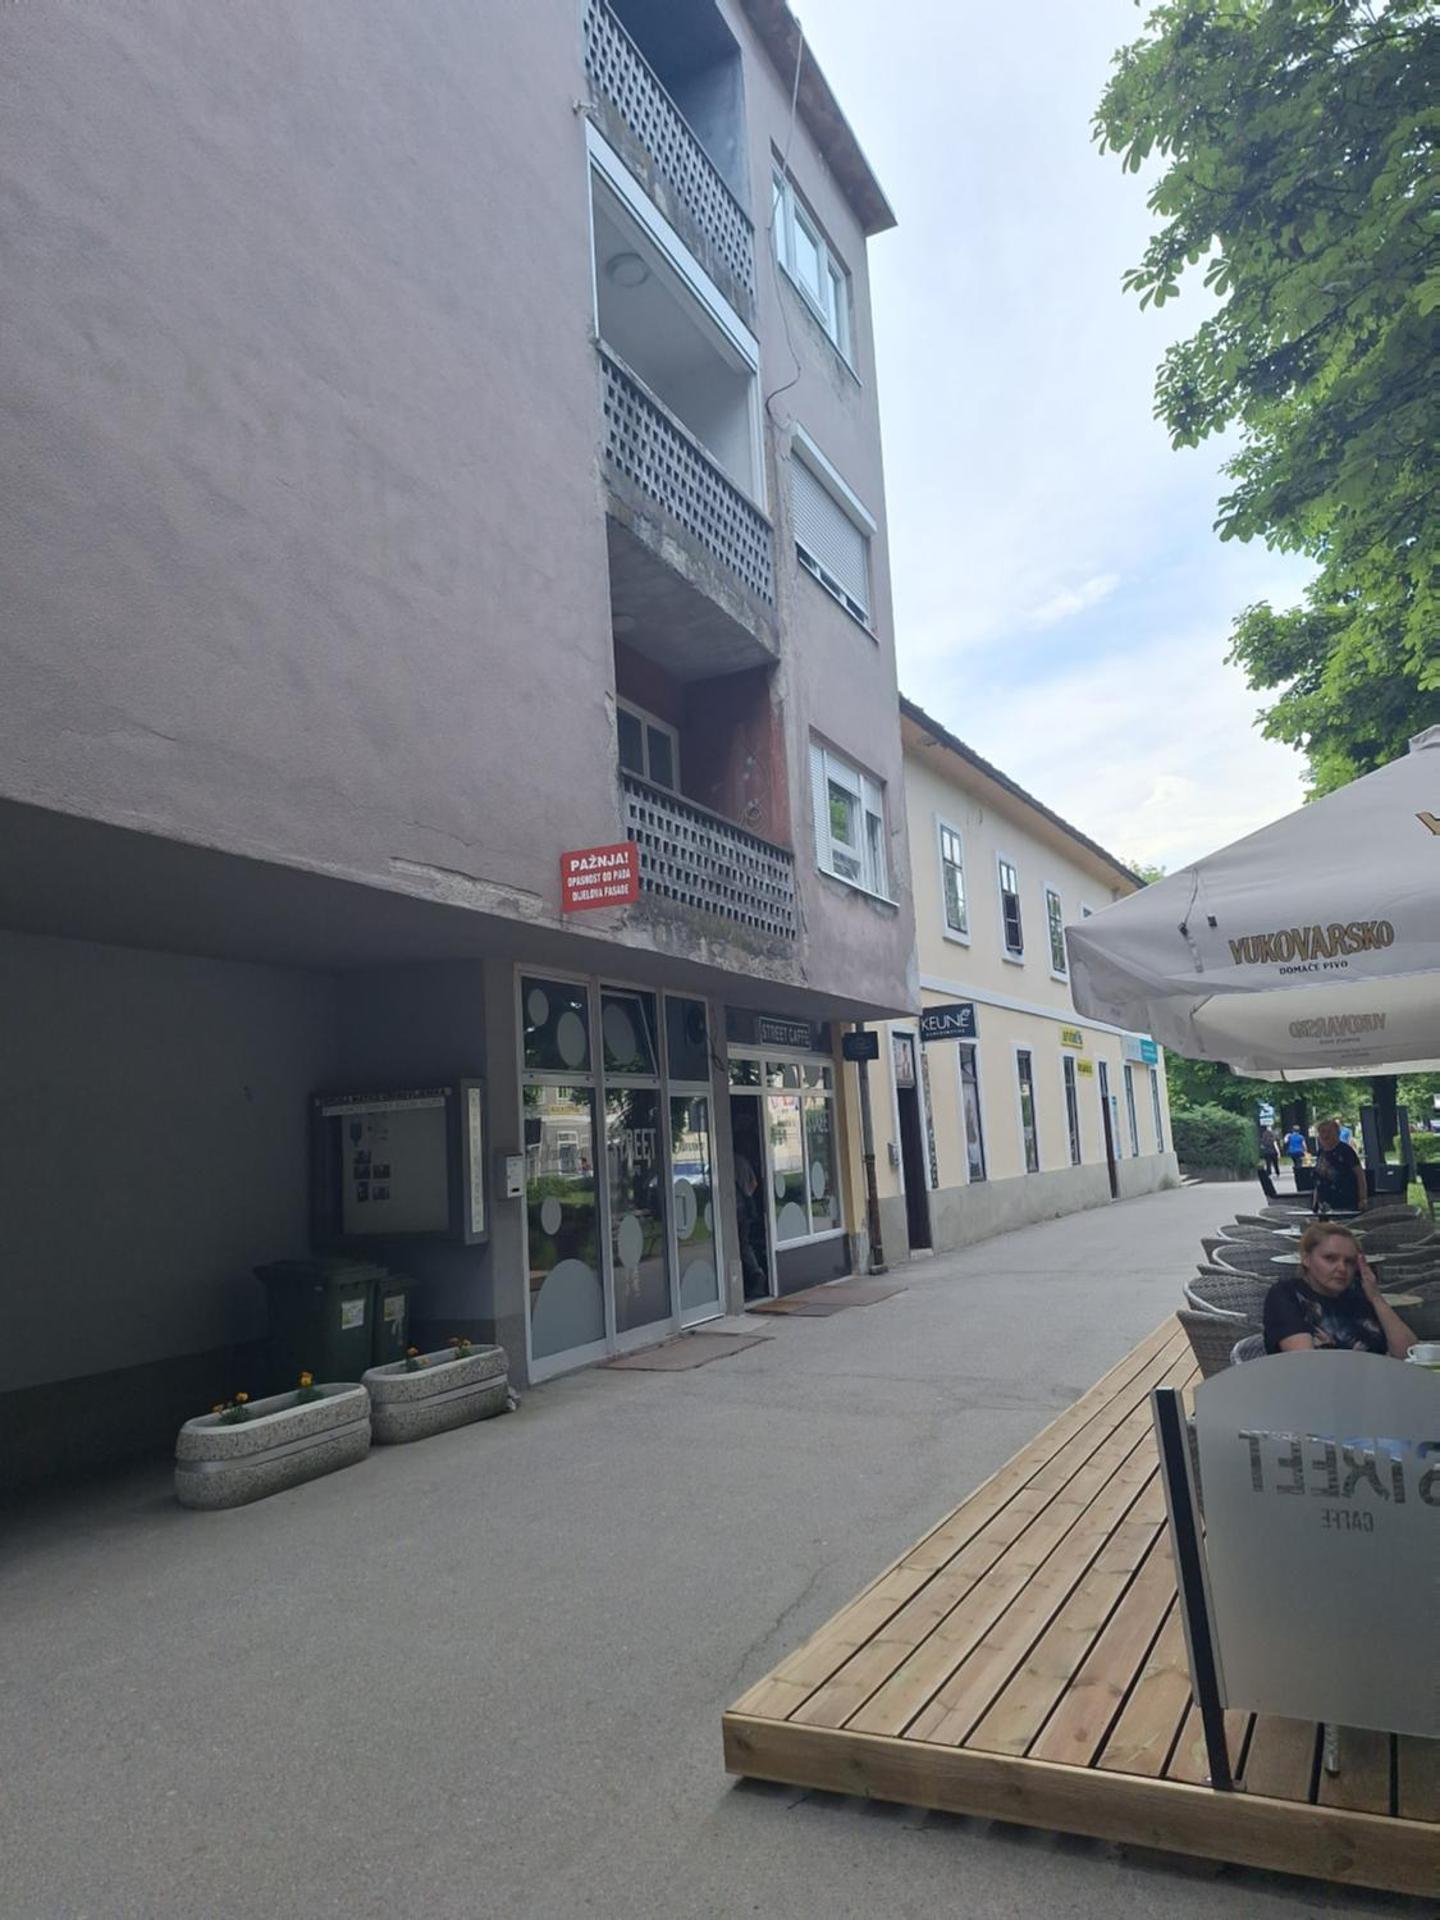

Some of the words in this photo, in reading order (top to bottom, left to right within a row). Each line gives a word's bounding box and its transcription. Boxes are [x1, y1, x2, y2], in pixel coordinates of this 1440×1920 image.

[570, 852, 629, 871] PAŽNJA!
[567, 873, 600, 888] OPASNOST
[602, 871, 612, 882] OD
[613, 868, 631, 881] PADA
[572, 887, 603, 902] DIJELOVA
[604, 884, 629, 897] FASADE
[1228, 920, 1395, 965] VUKOVARSKO
[1323, 960, 1348, 970] PIVO
[921, 1008, 970, 1031] KEUNE
[762, 1021, 787, 1042] STREET
